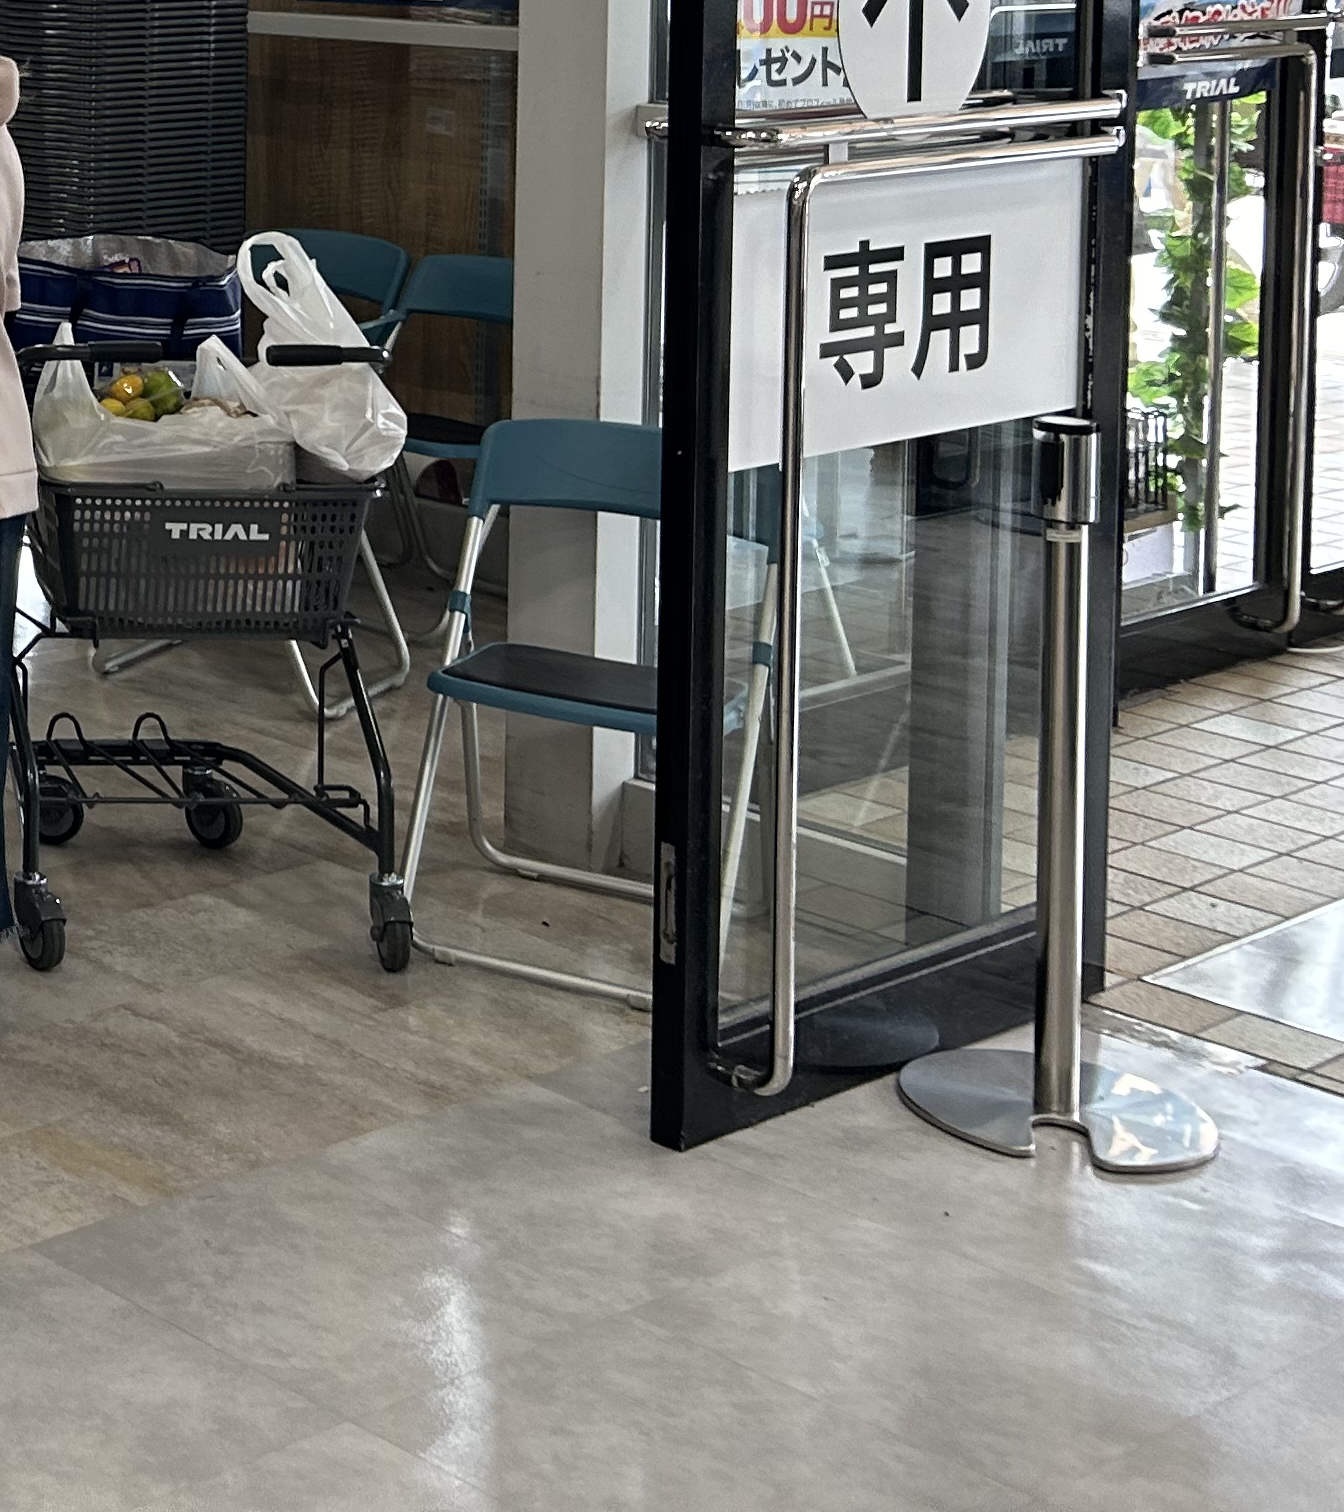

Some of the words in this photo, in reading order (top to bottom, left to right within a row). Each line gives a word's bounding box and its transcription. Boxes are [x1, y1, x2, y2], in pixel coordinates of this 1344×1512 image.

[1183, 76, 1241, 99] TRIAL
[818, 233, 992, 389] 専用
[165, 521, 270, 541] TRIAL
